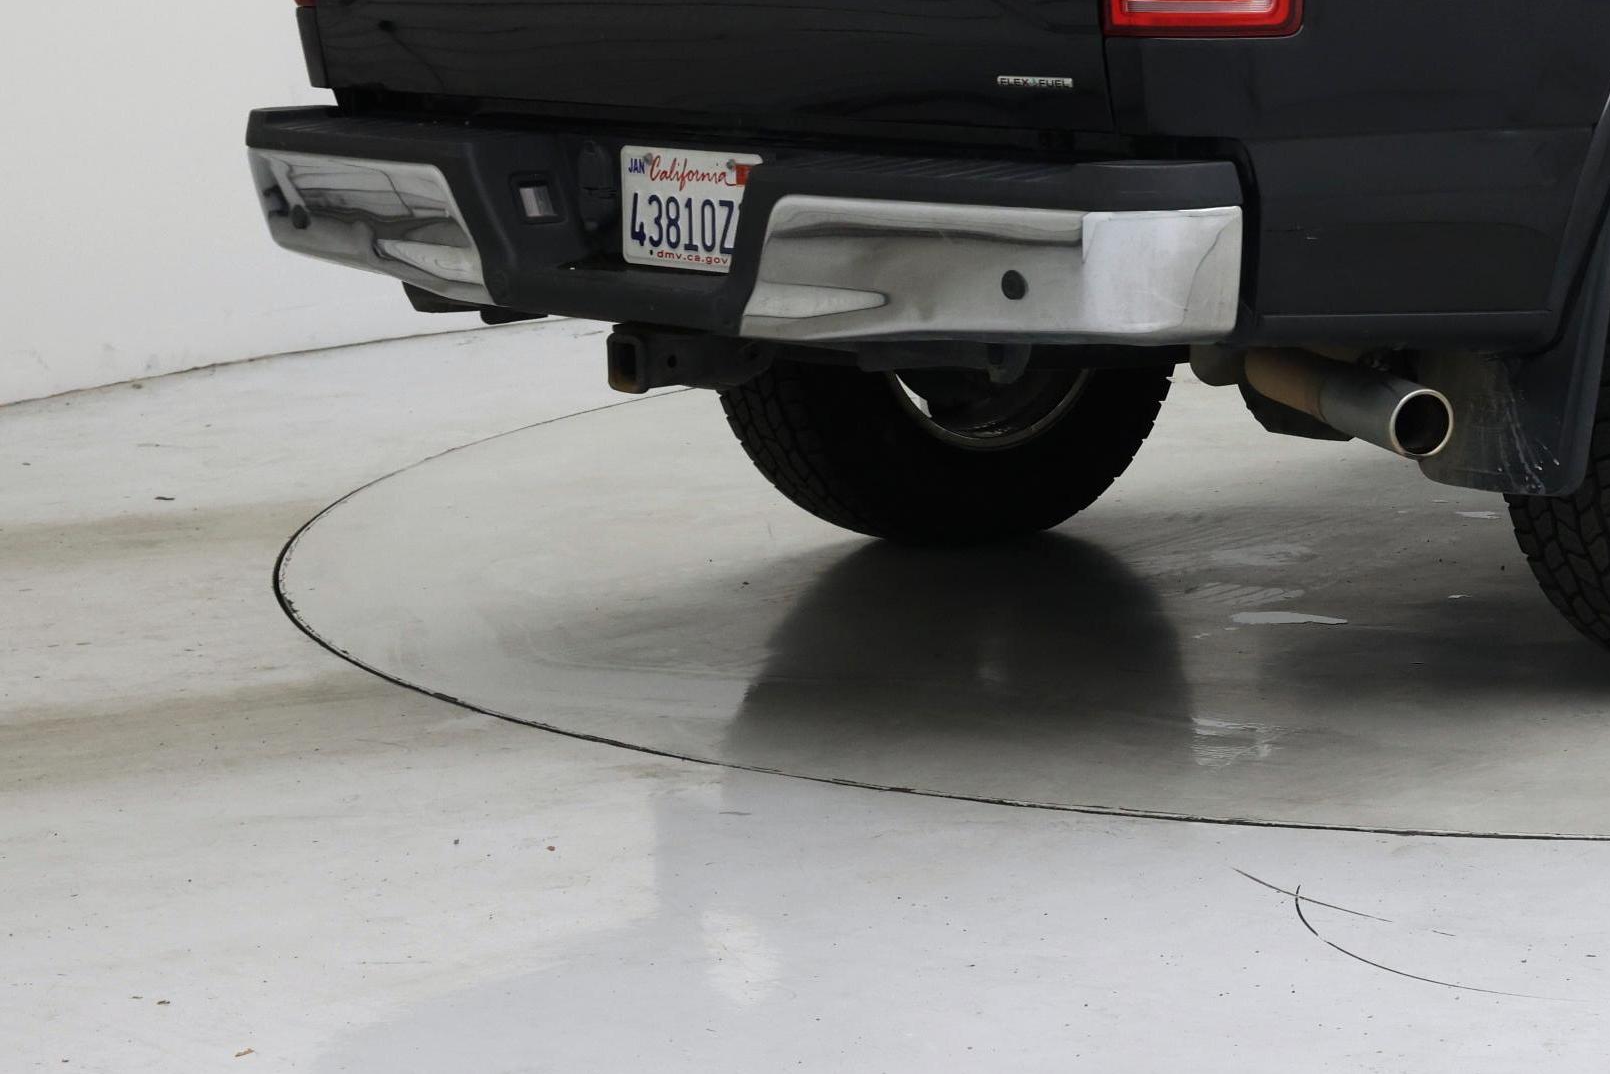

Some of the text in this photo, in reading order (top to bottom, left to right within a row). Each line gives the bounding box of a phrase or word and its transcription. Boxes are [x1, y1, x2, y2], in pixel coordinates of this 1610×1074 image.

[628, 155, 737, 191] JAN California
[630, 192, 741, 255] 43810Z
[656, 249, 729, 265] dmv.ca.gov
